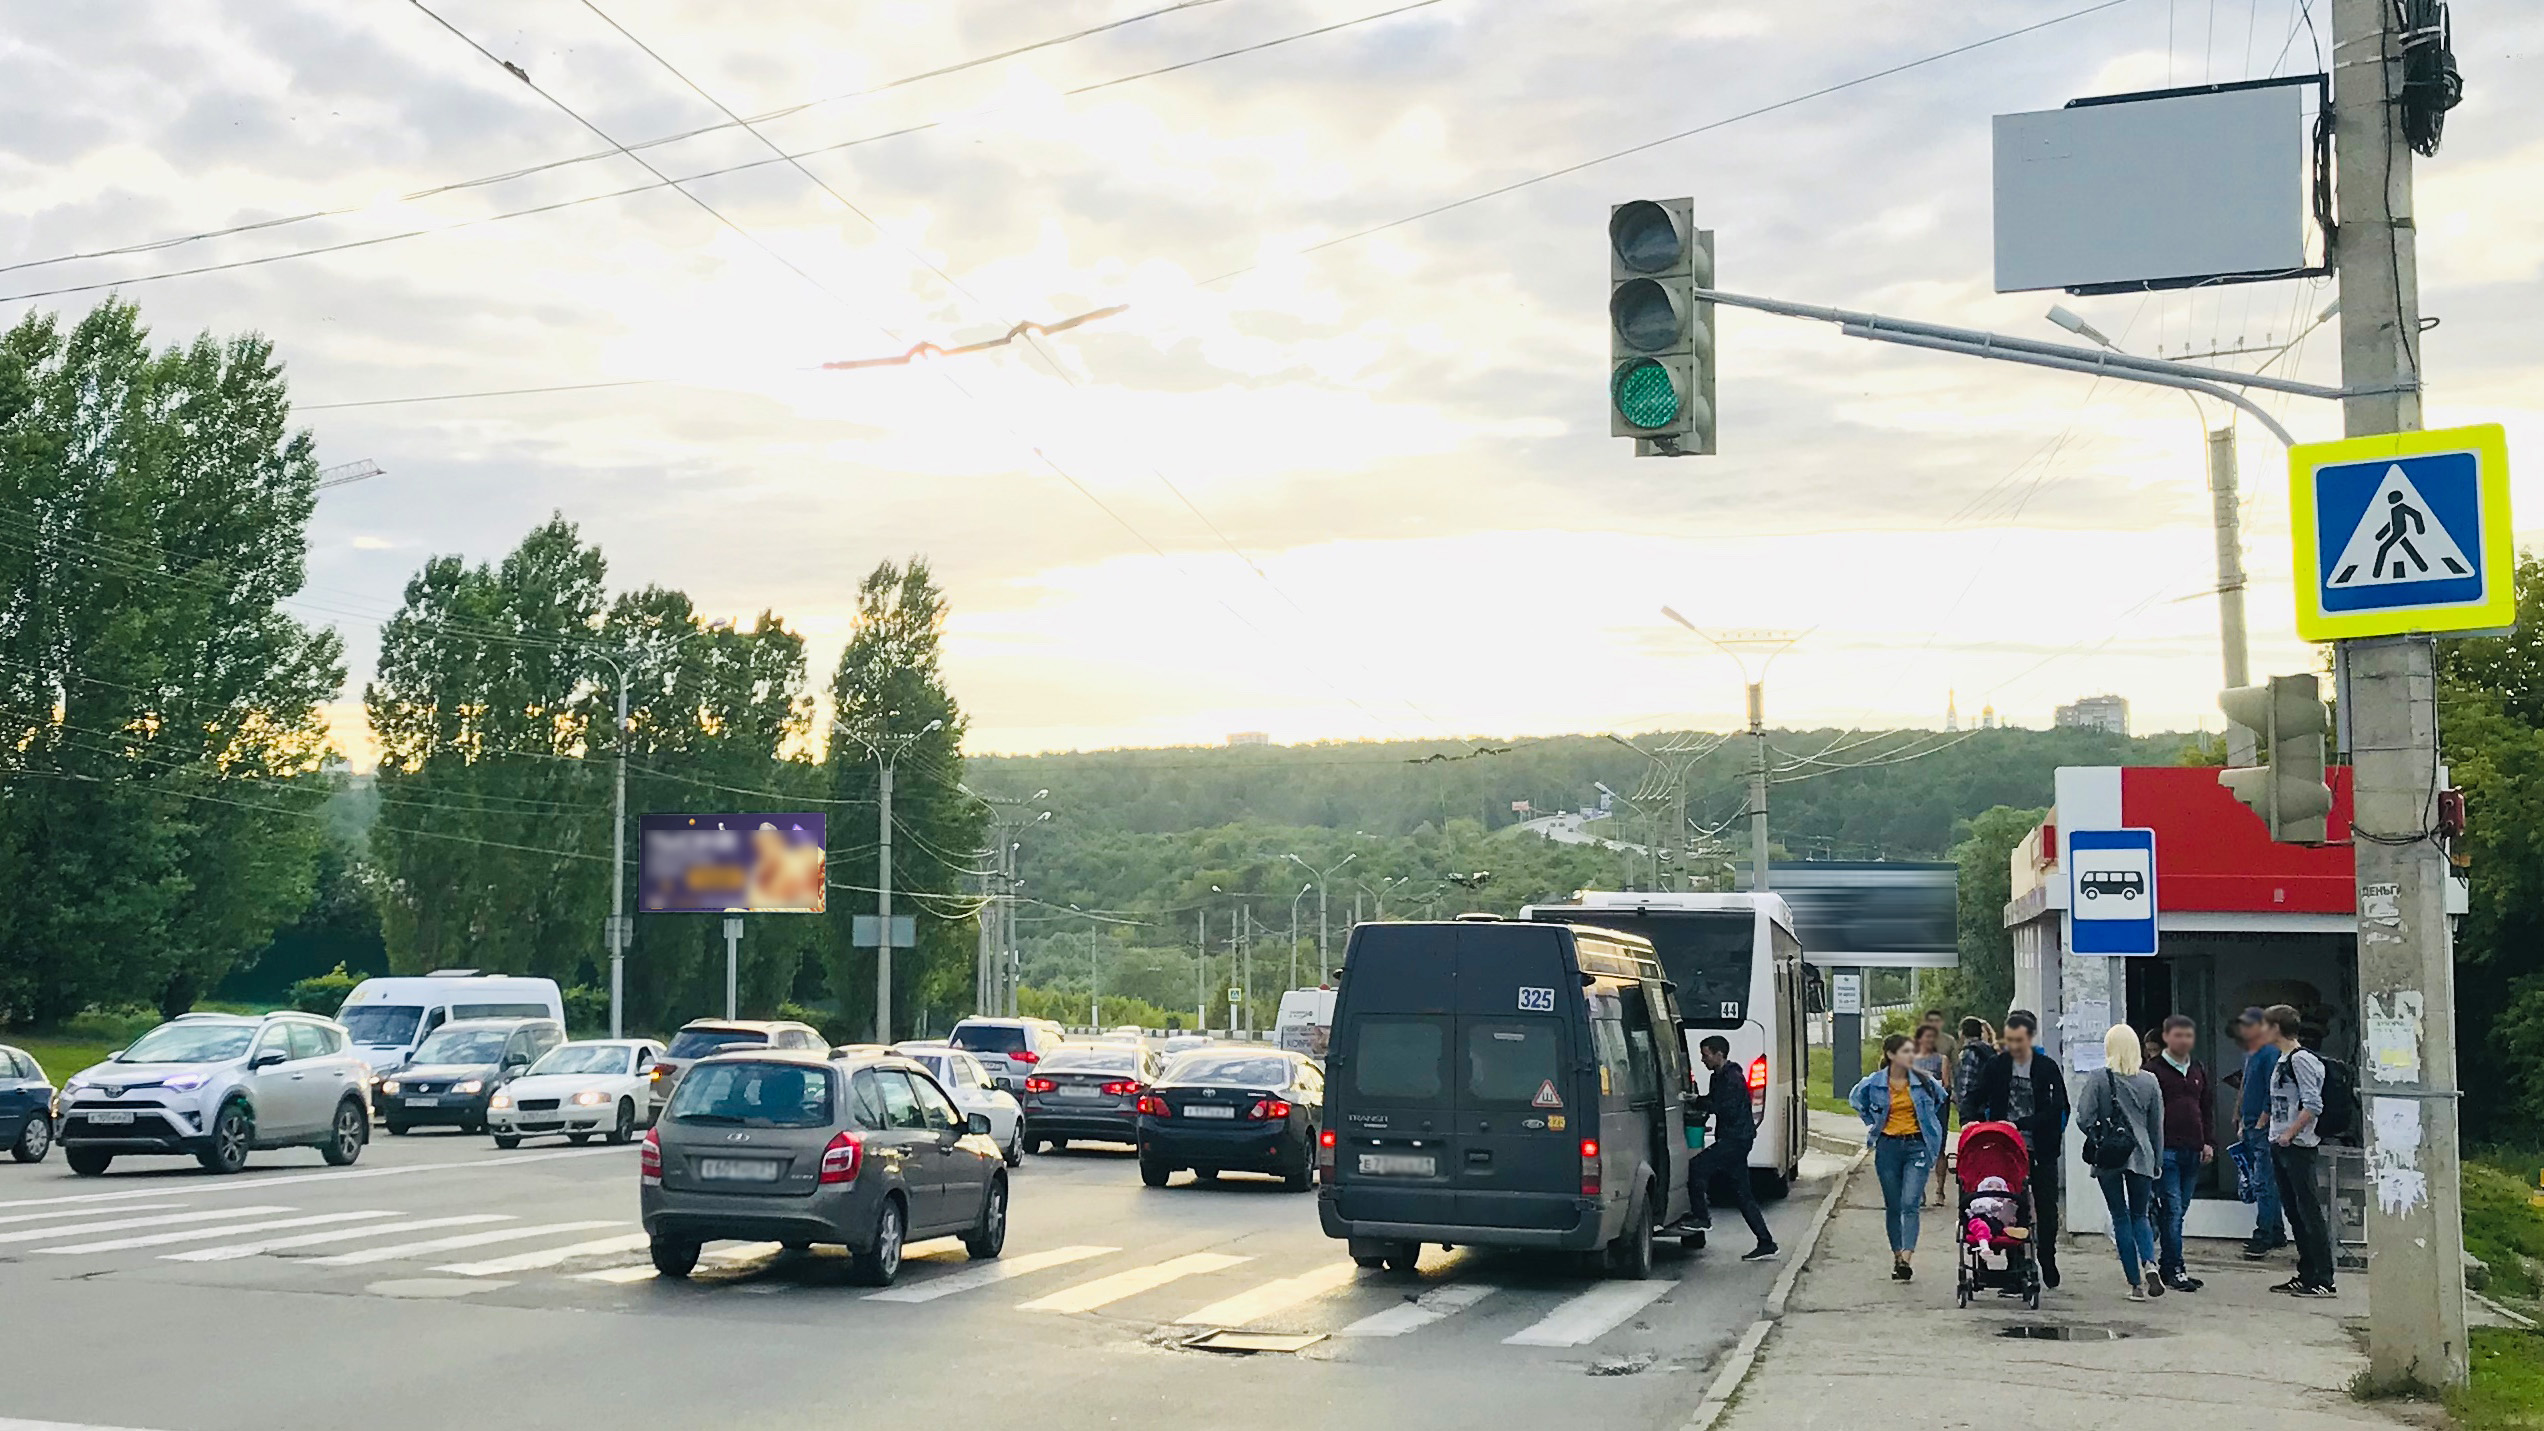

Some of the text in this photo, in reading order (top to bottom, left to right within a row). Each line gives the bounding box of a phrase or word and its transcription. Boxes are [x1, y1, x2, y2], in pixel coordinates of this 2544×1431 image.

[1521, 989, 1551, 1009] 325
[1723, 1003, 1736, 1017] 44
[1542, 1093, 1553, 1102] Ш
